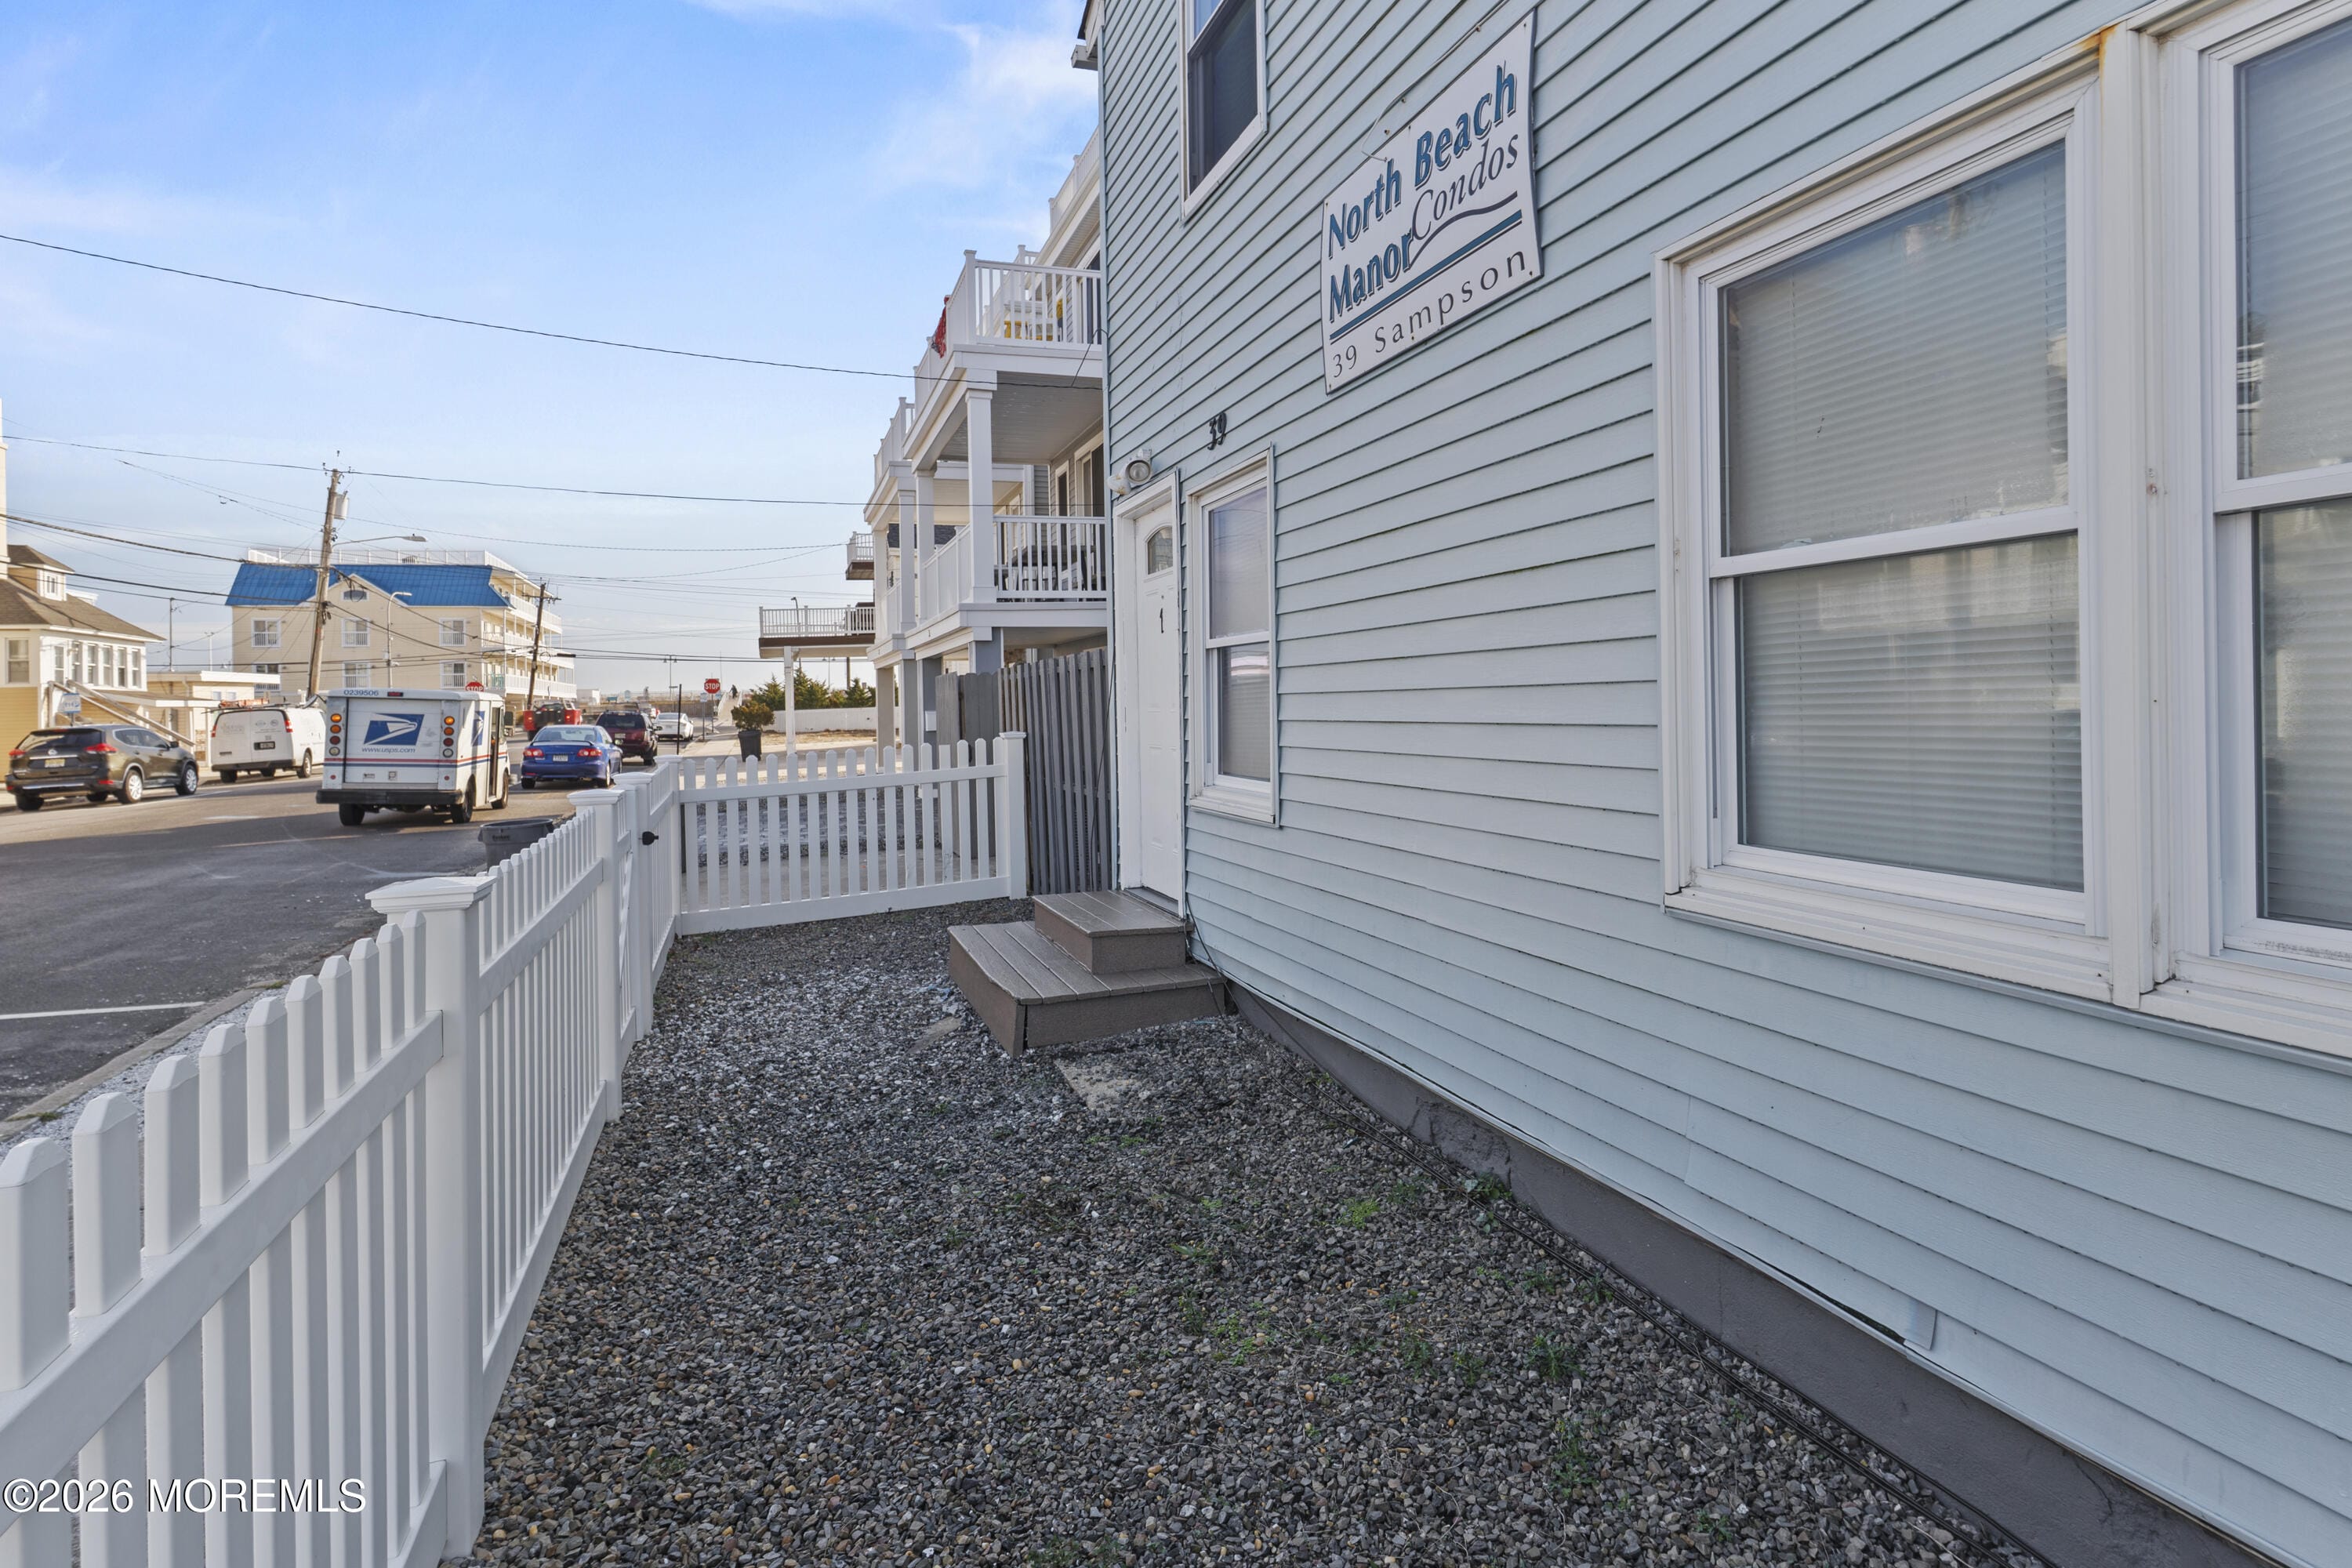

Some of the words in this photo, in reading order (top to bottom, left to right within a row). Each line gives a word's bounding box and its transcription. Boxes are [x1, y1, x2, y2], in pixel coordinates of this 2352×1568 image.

[1328, 158, 1402, 260] North
[1414, 60, 1517, 191] Beach
[1329, 227, 1413, 323] Manor
[1412, 134, 1519, 241] Condos
[1333, 345, 1357, 378] 39
[1374, 251, 1526, 353] Sampson
[1207, 412, 1227, 451] 39
